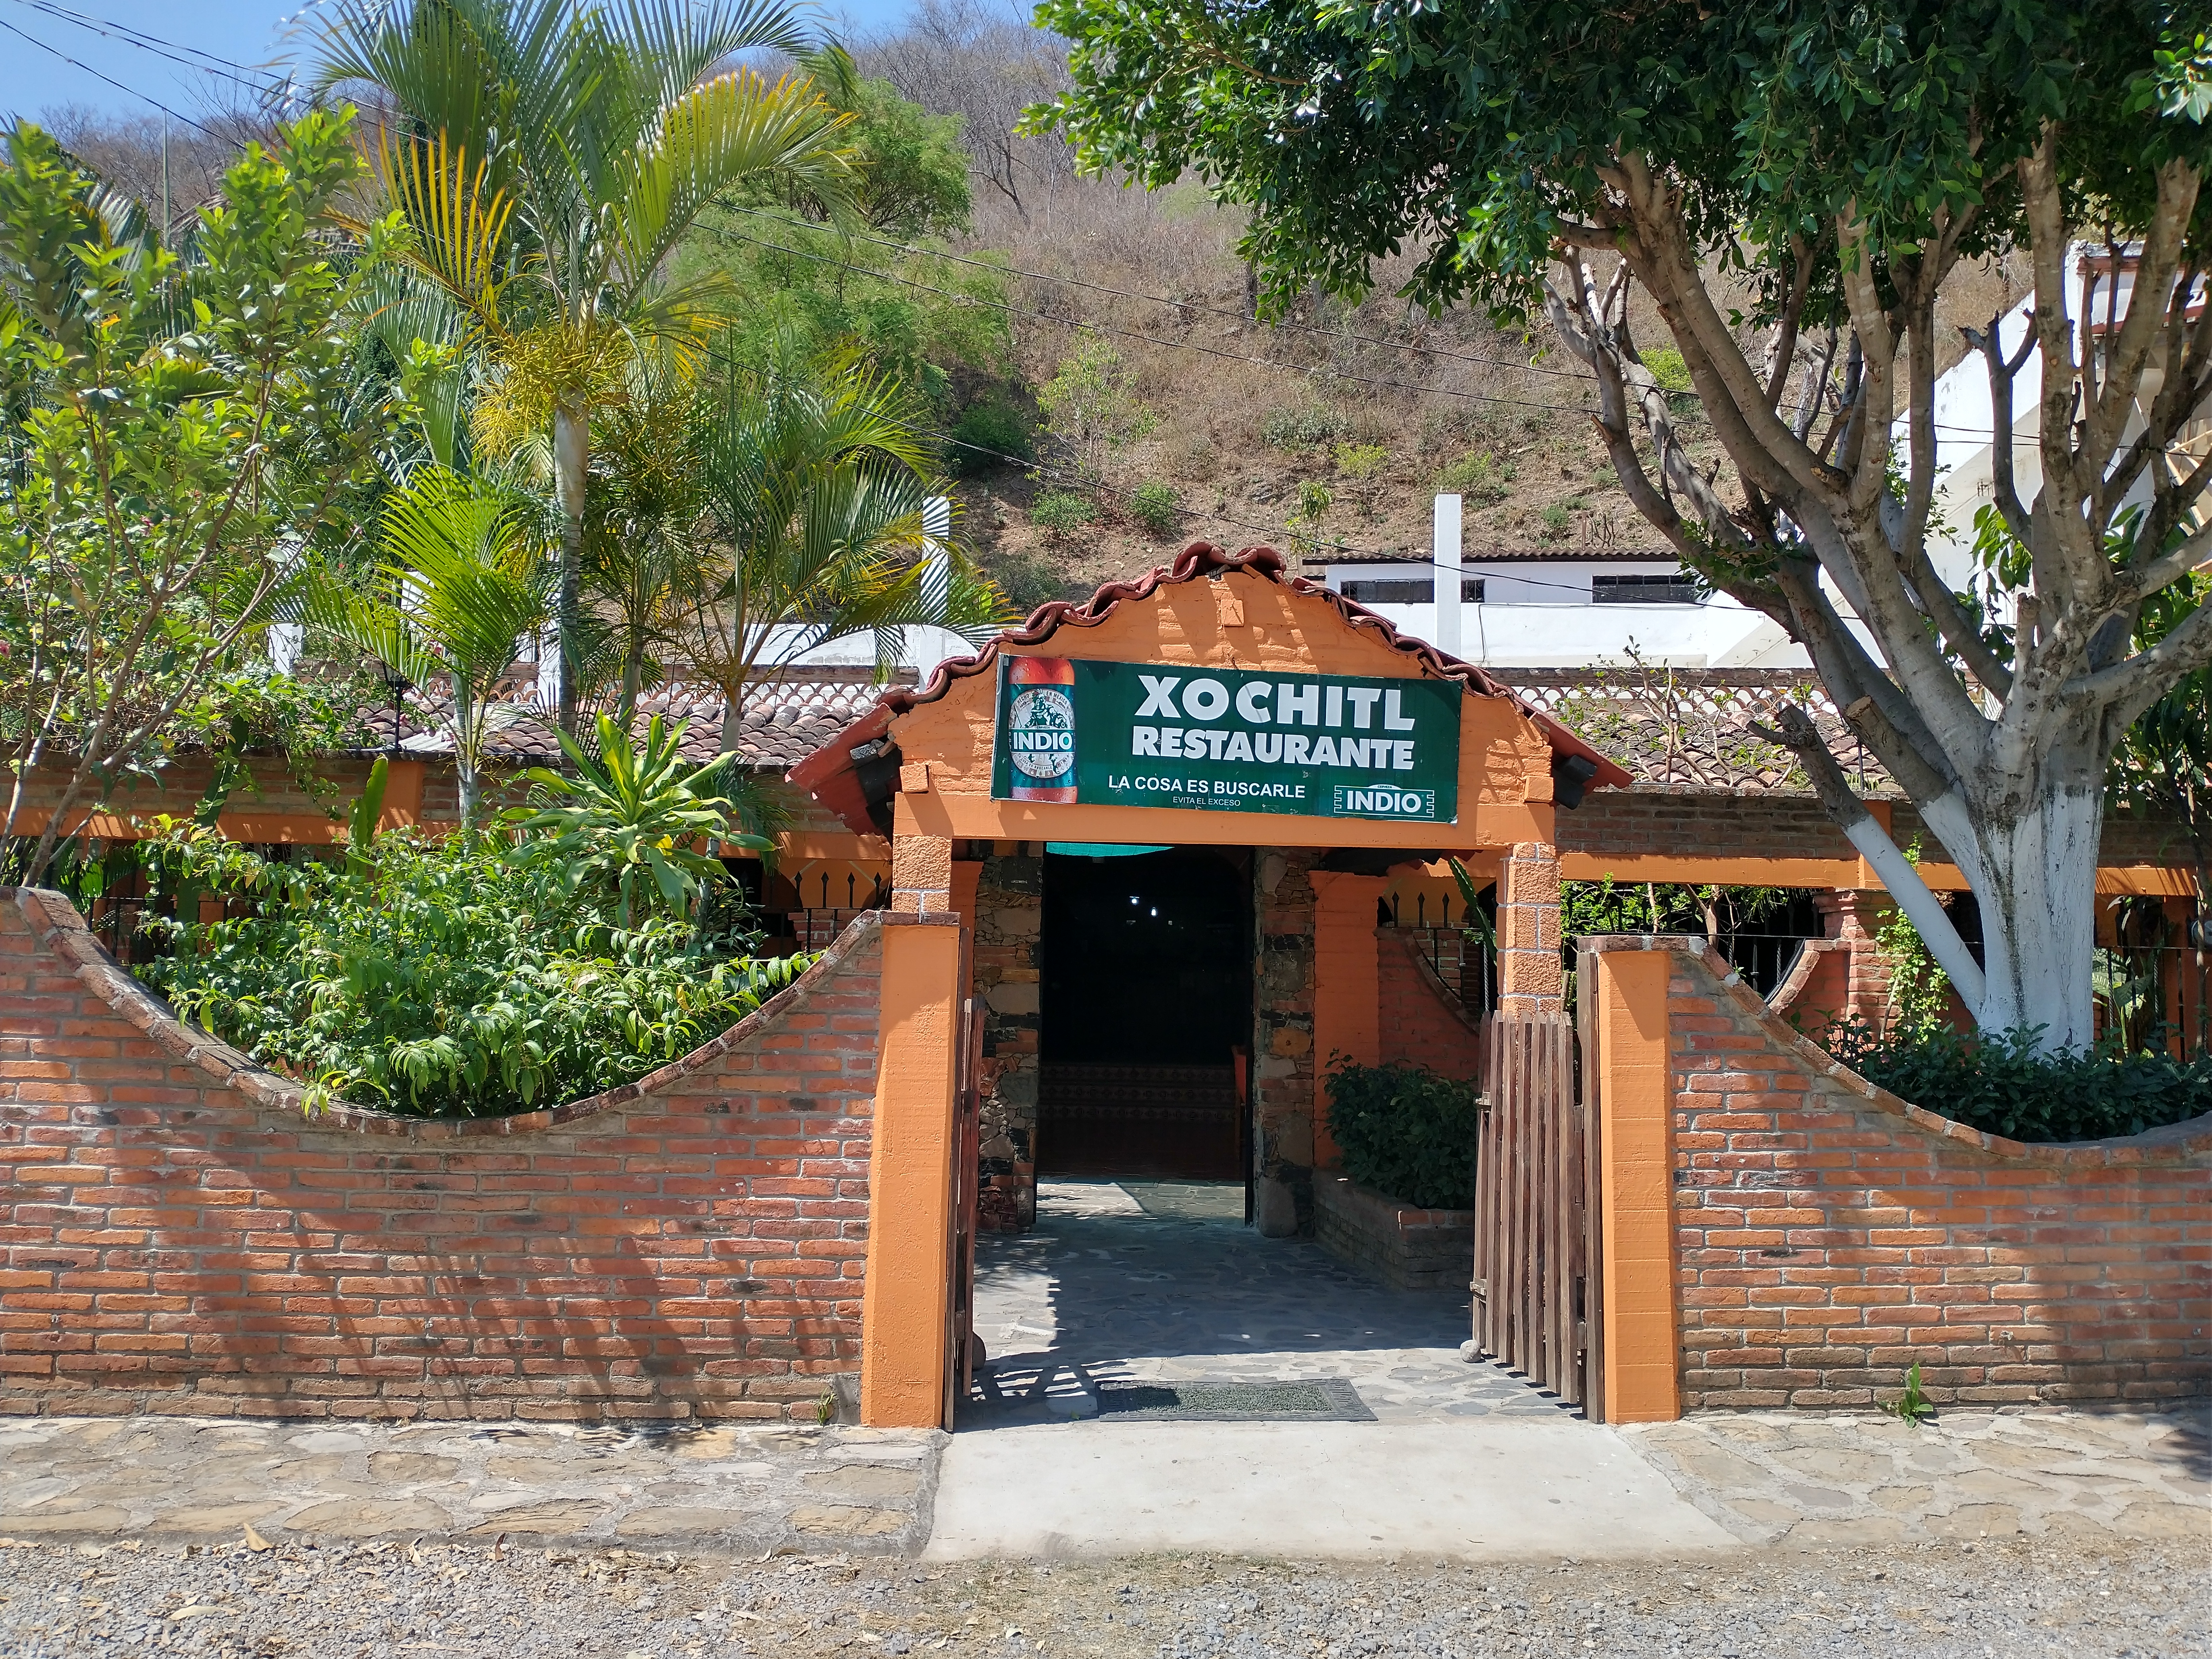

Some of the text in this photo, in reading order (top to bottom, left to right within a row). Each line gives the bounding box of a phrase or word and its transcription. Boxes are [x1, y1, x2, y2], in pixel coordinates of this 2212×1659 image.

[1017, 694, 1030, 704] HECHO
[1053, 693, 1068, 705] MEXICO
[1134, 675, 1415, 730] XOCHITL
[1013, 732, 1072, 750] INDIO
[1132, 725, 1415, 769] RESTAURANTE
[1108, 775, 1305, 798] LA COSA ES BUSCARLE
[1208, 798, 1241, 806] EXCESO
[1347, 790, 1421, 813] INDIO
